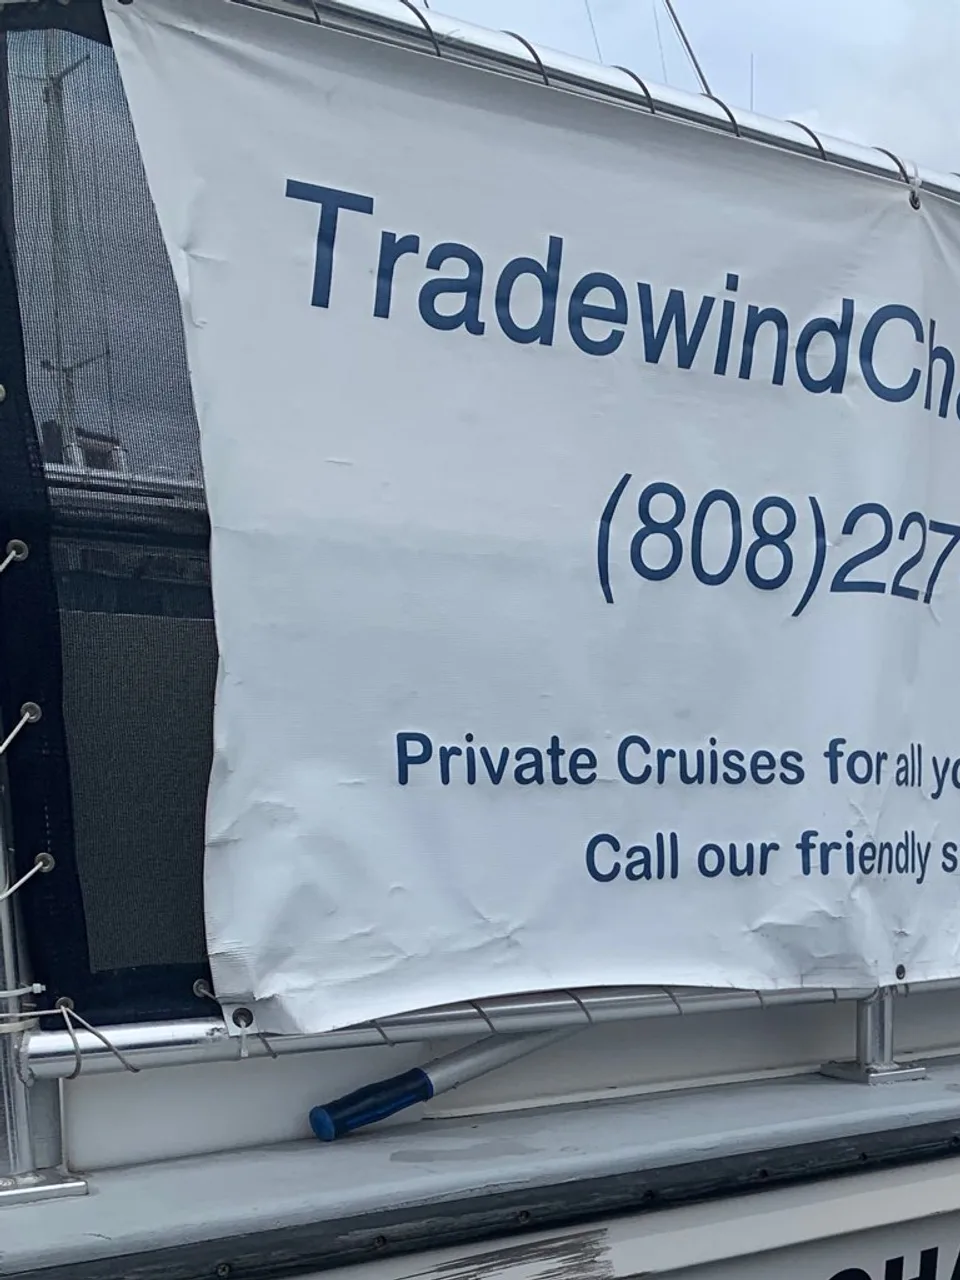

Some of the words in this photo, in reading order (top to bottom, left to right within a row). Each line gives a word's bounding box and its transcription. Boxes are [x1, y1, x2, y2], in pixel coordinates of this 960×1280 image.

[397, 732, 598, 788] Private
[617, 734, 805, 787] Cruises
[823, 736, 889, 787] for
[895, 742, 924, 788] all
[586, 830, 680, 884] Call
[697, 842, 780, 879] our
[795, 829, 932, 885] friendly
